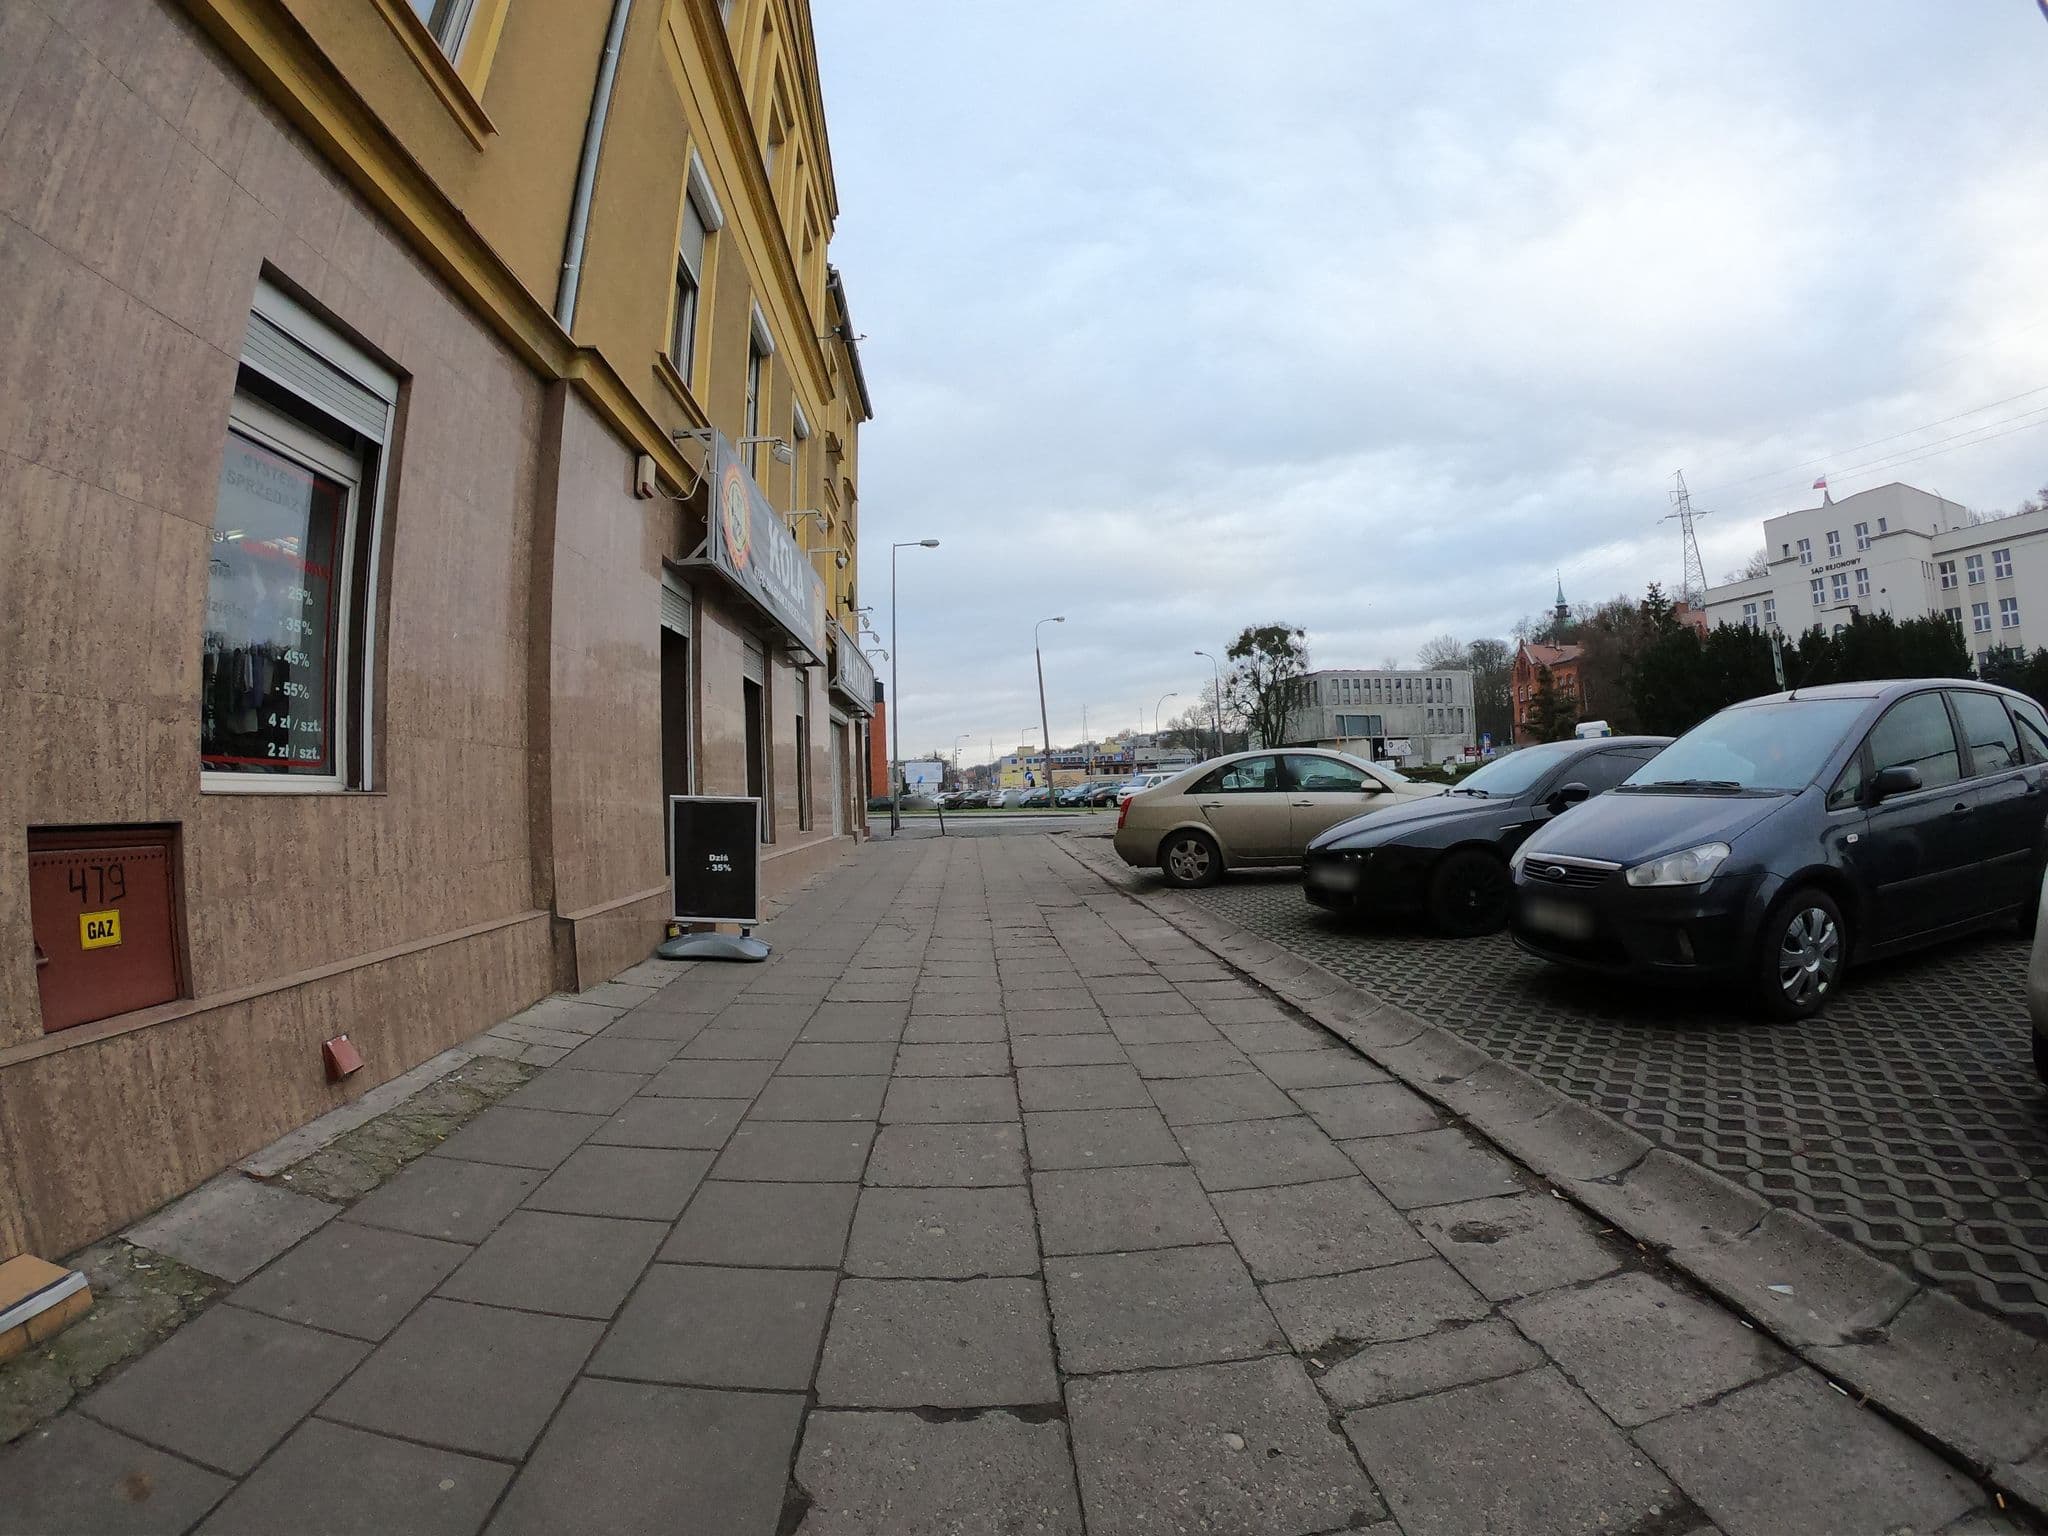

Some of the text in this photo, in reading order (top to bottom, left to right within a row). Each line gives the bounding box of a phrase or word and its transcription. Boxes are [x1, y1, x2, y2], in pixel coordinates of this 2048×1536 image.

[1811, 557, 1861, 575] SĄD REJONOWY
[286, 617, 313, 636] 35%
[283, 650, 310, 668] 45%
[283, 681, 310, 700] 55%
[268, 713, 277, 728] 4
[280, 715, 291, 729] zł
[300, 719, 322, 733] szt.
[267, 742, 276, 757] 2
[278, 744, 290, 758] zł
[299, 746, 321, 760] szt.
[711, 863, 732, 872] 35%
[68, 863, 126, 904] 479
[87, 920, 114, 940] GAZ
